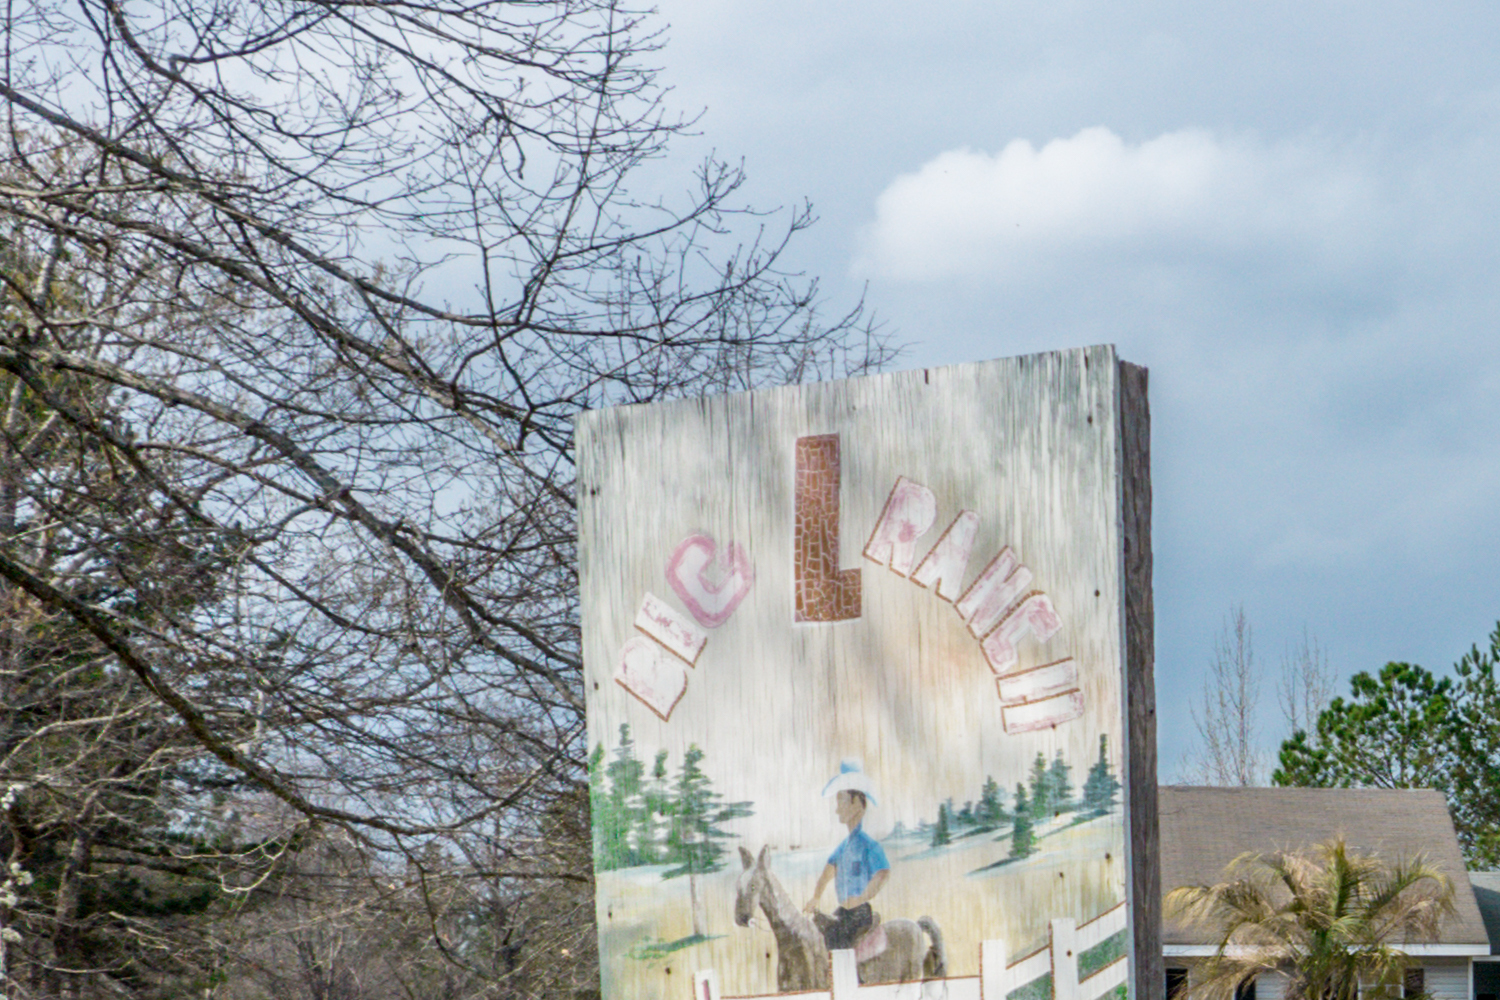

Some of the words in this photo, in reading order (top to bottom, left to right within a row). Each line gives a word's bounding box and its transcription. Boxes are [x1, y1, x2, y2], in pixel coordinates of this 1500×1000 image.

[614, 533, 752, 723] BIG
[793, 432, 863, 624] L
[862, 475, 1085, 736] RANCH
